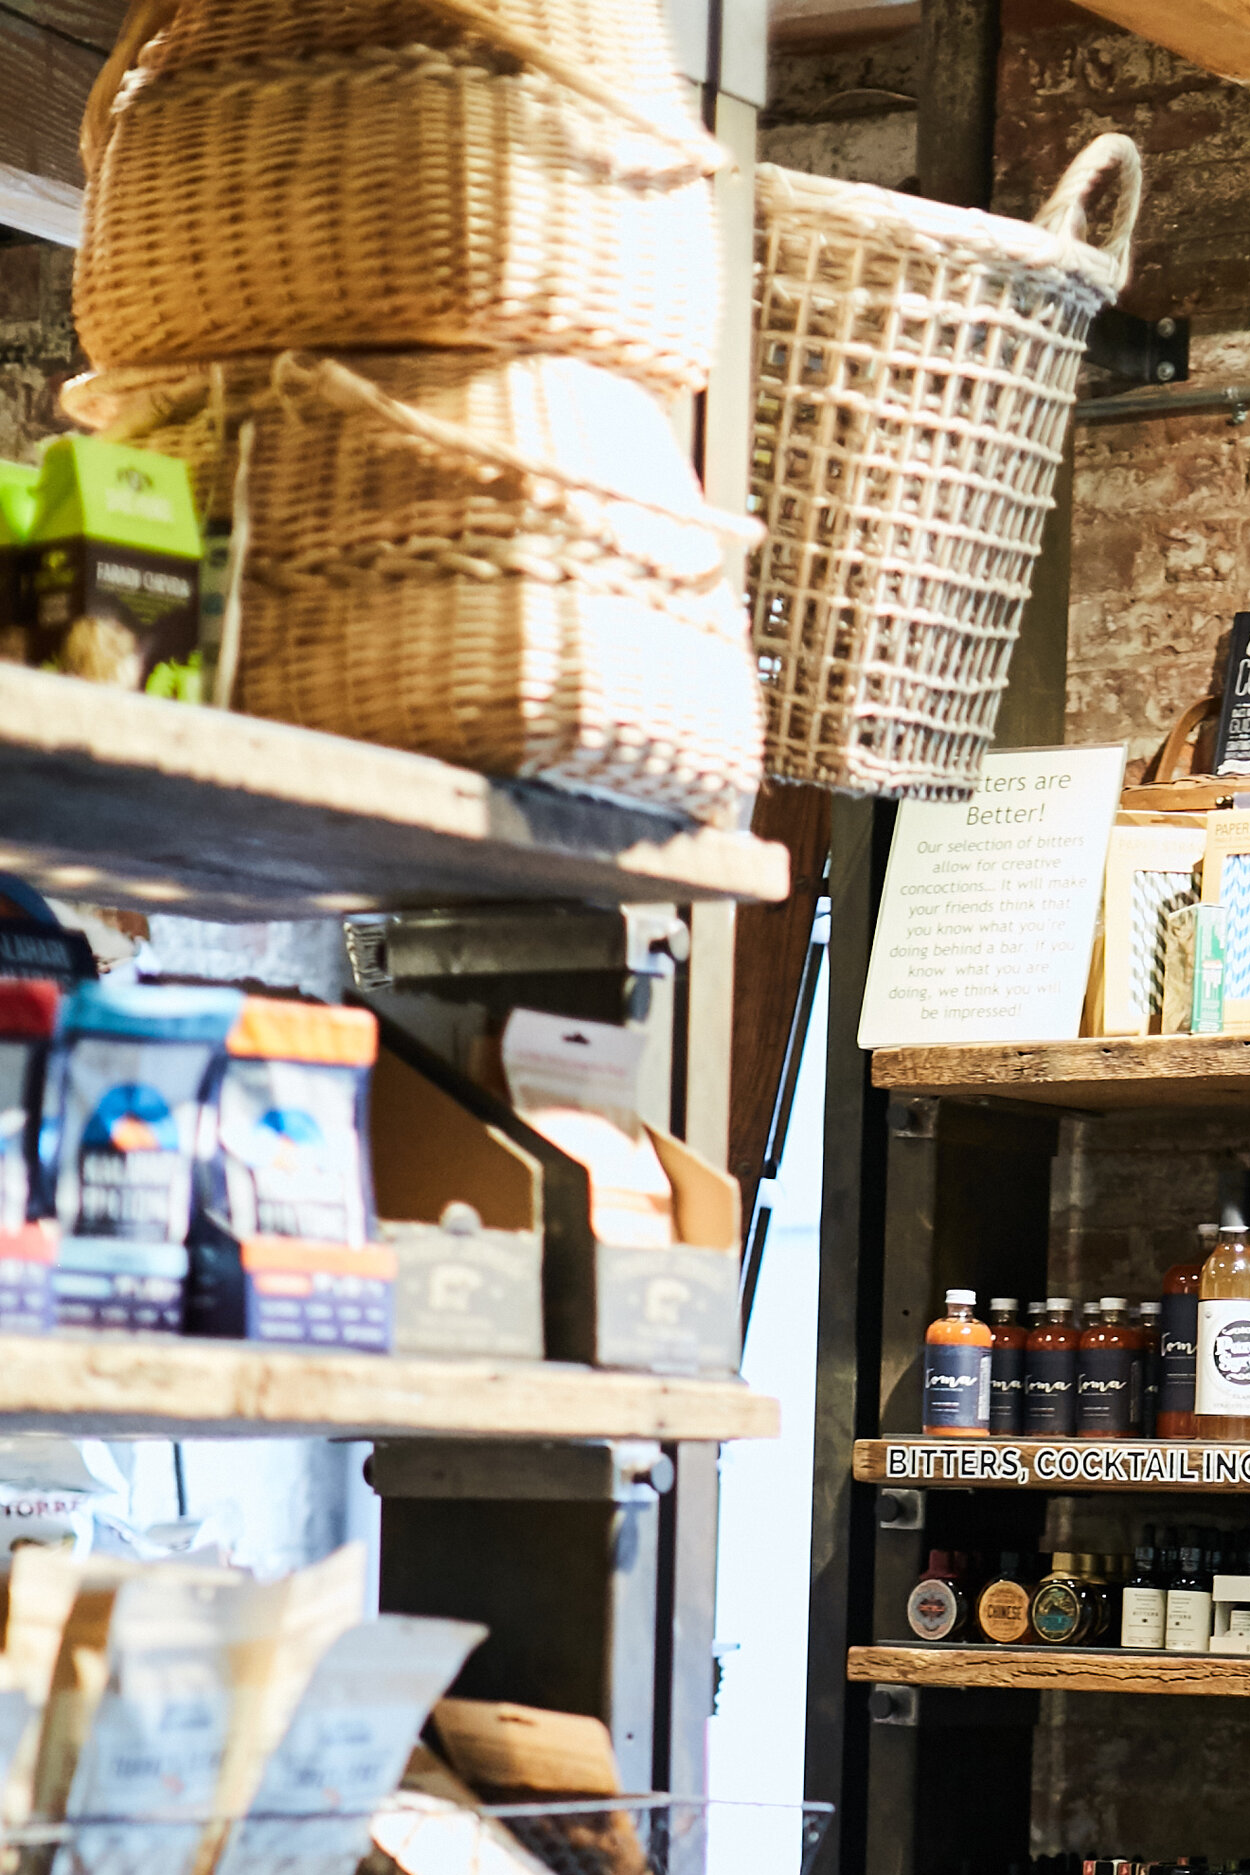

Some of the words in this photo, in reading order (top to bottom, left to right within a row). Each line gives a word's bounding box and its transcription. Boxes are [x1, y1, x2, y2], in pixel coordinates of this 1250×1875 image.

[974, 774, 1026, 794] tters
[1034, 773, 1073, 791] are
[966, 802, 1046, 827] Better!
[1214, 821, 1250, 836] PAPER
[916, 840, 944, 855] Our
[946, 836, 1014, 853] selection
[1016, 835, 1035, 851] of
[1036, 834, 1086, 850] bitters
[931, 860, 972, 875] allow
[975, 858, 997, 873] for
[1001, 856, 1063, 872] creative
[1000, 878, 1012, 892] It
[1016, 877, 1044, 891] will
[1047, 875, 1088, 890] make
[907, 903, 940, 919] your
[944, 898, 995, 915] friends
[998, 898, 1037, 913] think
[1040, 896, 1072, 911] that
[905, 924, 933, 941] you
[935, 921, 975, 937] know
[977, 919, 1015, 935] what
[888, 943, 929, 963] doing
[931, 941, 983, 958] behind
[985, 944, 996, 956] a
[907, 964, 946, 979] know
[954, 961, 990, 978] what
[994, 962, 1022, 980] you
[1025, 961, 1050, 975] are
[887, 985, 932, 1003] doing,
[937, 985, 959, 999] we
[963, 982, 1001, 999] think
[1003, 985, 1031, 1001] you
[920, 1006, 939, 1021] be
[943, 1004, 1022, 1023] impressed!
[1160, 1331, 1199, 1357] Tom
[990, 1379, 1023, 1393] ma
[886, 1445, 1030, 1485] BITTERS,
[1033, 1446, 1199, 1483] COCKTAIL
